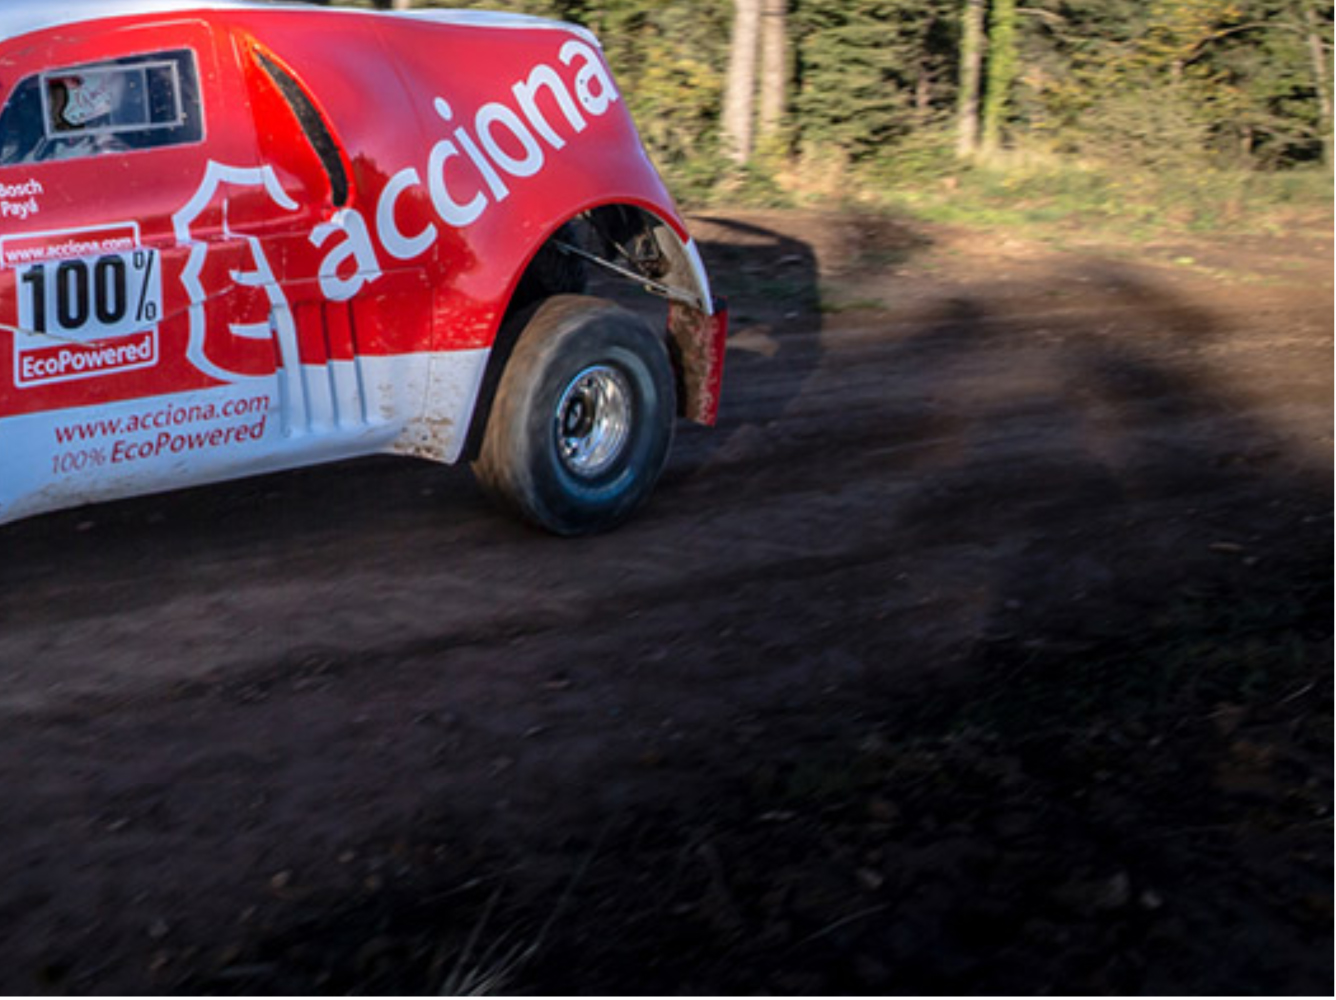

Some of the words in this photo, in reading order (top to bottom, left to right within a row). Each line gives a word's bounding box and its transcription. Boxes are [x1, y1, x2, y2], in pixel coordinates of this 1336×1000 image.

[309, 38, 619, 301] acciona
[5, 237, 132, 262] www.acciona.com
[21, 249, 157, 334] 100%
[22, 335, 152, 378] EcoPowered
[52, 447, 106, 474] 100%
[111, 415, 266, 463] EcoPowered
[55, 395, 270, 444] www.acciona.com
